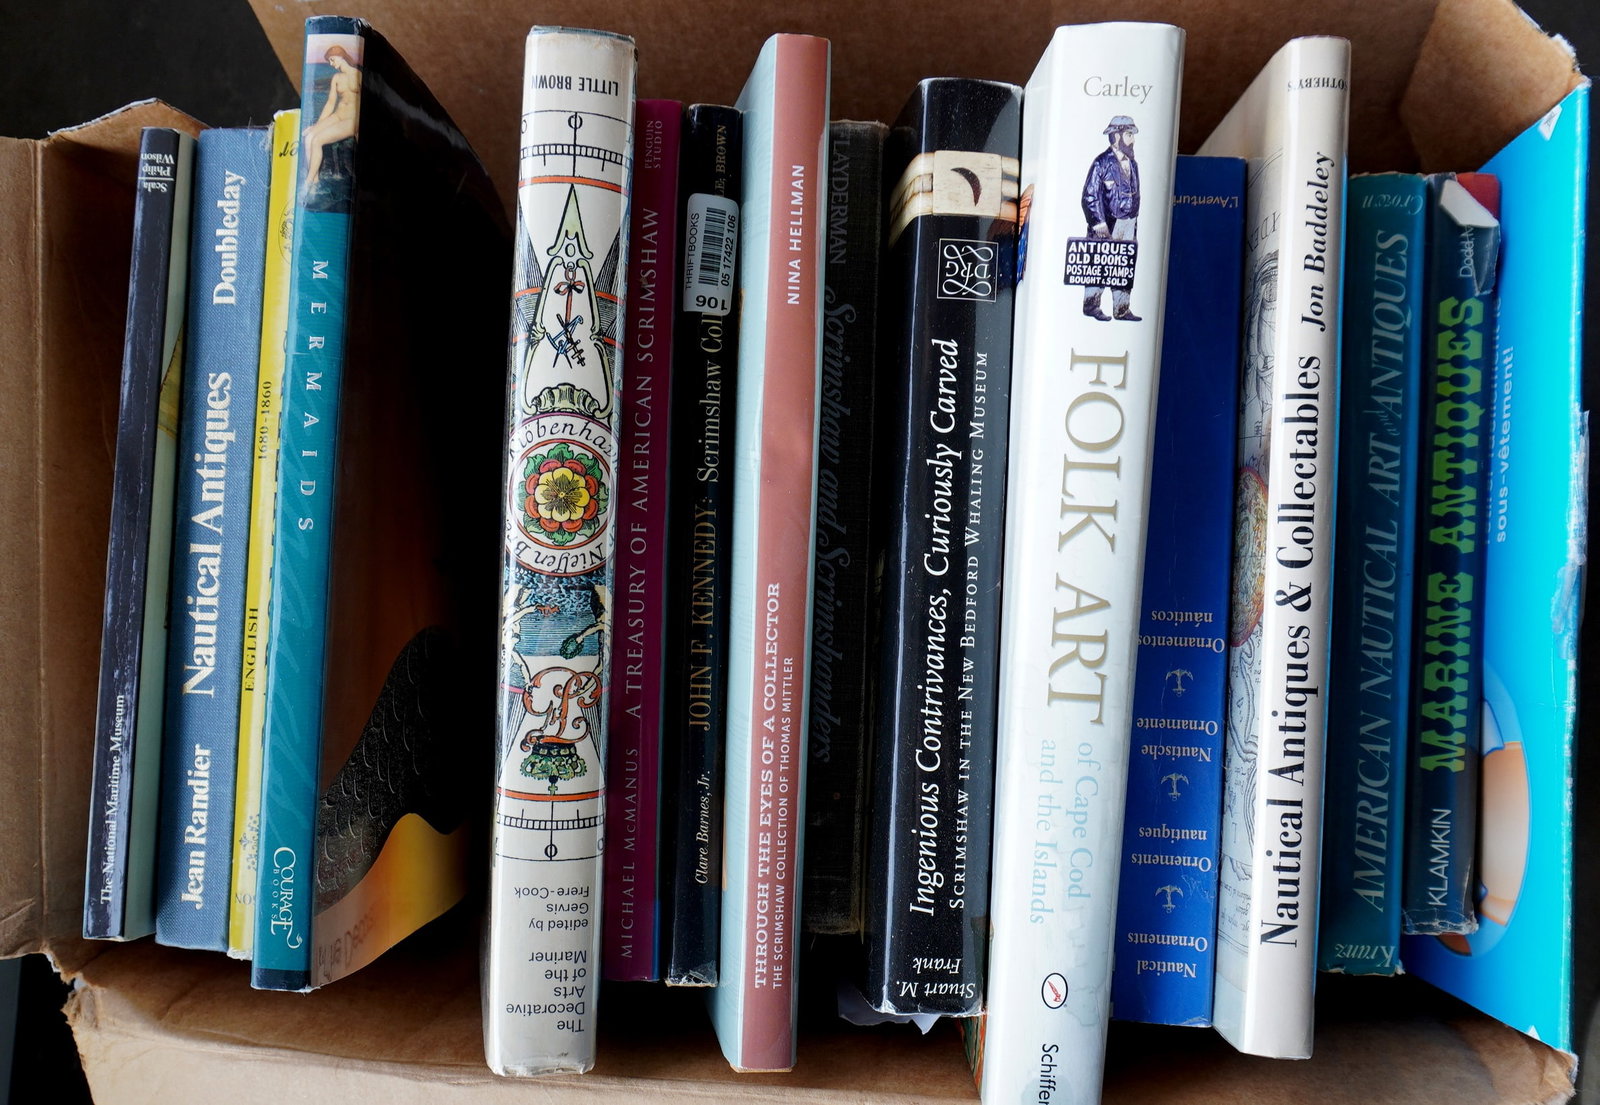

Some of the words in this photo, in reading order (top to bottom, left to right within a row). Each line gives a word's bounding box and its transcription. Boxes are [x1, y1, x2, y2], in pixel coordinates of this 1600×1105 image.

[531, 74, 572, 91] BROWN
[579, 77, 619, 97] LITTLE
[1083, 75, 1153, 104] Carley
[141, 153, 175, 165] Wilson
[645, 120, 655, 169] PENGUIN
[654, 120, 662, 169] STUDIO
[715, 124, 727, 174] BROWN
[142, 165, 172, 177] Philip
[143, 181, 168, 193] Scala
[727, 215, 736, 237] 106
[789, 164, 805, 251] HELLMAN
[1304, 152, 1335, 275] Baddeley
[213, 170, 248, 305] Doubleday
[685, 212, 700, 290] THRIFTBOOKS
[722, 239, 734, 268] 17422
[1068, 242, 1135, 256] ANTIQUES
[1068, 253, 1091, 265] OLD
[1094, 254, 1128, 267] BOOKS
[636, 208, 659, 362] SCRIMSHAW
[721, 271, 731, 287] 05
[787, 259, 801, 305] NINA
[1066, 265, 1102, 276] POSTAGE
[1103, 266, 1134, 278] STAMPS
[1069, 276, 1101, 285] BOUGHT
[1106, 277, 1128, 286] SOLD
[1301, 283, 1326, 332] Jon
[1371, 230, 1412, 418] ANTIQUES
[298, 260, 329, 531] MERMAIDS
[821, 285, 857, 463] Scrimshaw
[930, 338, 959, 434] Carved
[631, 376, 651, 512] AMERICAN
[697, 360, 722, 483] Scrimshaw
[1428, 297, 1485, 554] ANTIQUES
[1496, 346, 1515, 543] sous-vêtement!
[191, 372, 236, 537] Antiques
[1058, 348, 1128, 553] FOLK
[1275, 356, 1321, 569] Collectables
[1369, 432, 1400, 506] ART
[817, 468, 846, 534] and
[924, 443, 962, 577] Curiously
[630, 523, 648, 554] OF
[691, 496, 717, 626] KENNEDY:
[182, 543, 223, 699] Nautical
[1152, 610, 1213, 627] náuticos
[1274, 581, 1312, 613] &
[1360, 520, 1398, 700] NAUTICAL
[245, 607, 259, 693] ENGLISH
[626, 566, 646, 694] TREASURY
[691, 633, 713, 655] F.
[764, 583, 779, 711] COLLECTOR
[811, 528, 851, 764] Scrimshanders
[1047, 572, 1112, 728] ART
[1137, 635, 1225, 653] Ornamentos
[689, 664, 713, 731] JOHN
[783, 657, 793, 712] MITTLER
[916, 589, 953, 772] Contrivances,
[1419, 572, 1474, 773] MARINE
[109, 694, 126, 754] Museum
[626, 704, 641, 719] A
[764, 715, 775, 732] A
[1136, 718, 1218, 736] Ornamente
[1268, 625, 1318, 786] Antiques
[762, 736, 774, 765] OF
[780, 716, 791, 772] THOMAS
[1040, 739, 1063, 784] and
[1077, 742, 1101, 771] of
[1141, 745, 1212, 762] Nautische
[106, 755, 122, 817] Maritime
[184, 743, 213, 846] Randier
[697, 769, 711, 790] Jr.
[760, 768, 773, 827] EYES
[779, 775, 789, 793] OF
[696, 792, 712, 844] Barnes,
[1036, 793, 1062, 832] the
[1066, 775, 1098, 838] Cape
[1352, 711, 1392, 913] AMERICAN
[103, 818, 119, 880] National
[758, 832, 771, 876] THE
[776, 797, 788, 880] COLLECTION
[910, 782, 944, 916] Ingenious
[1139, 823, 1207, 844] nautiques
[1429, 808, 1452, 906] KLAMKIN
[181, 851, 206, 910] Jean
[694, 847, 708, 885] Clare
[1030, 841, 1058, 924] Islands
[1068, 847, 1093, 900] Cod
[1131, 853, 1212, 872] Ornements
[1260, 797, 1305, 947] Nautical
[100, 881, 114, 905] The
[270, 868, 280, 920] BOOKS
[270, 847, 301, 944] COURAGE
[514, 886, 589, 899] Frere-Cook
[547, 903, 589, 915] Gervis
[621, 862, 636, 958] MICHAEL
[529, 918, 544, 931] by
[547, 918, 588, 930] edited
[755, 883, 769, 988] THROUGH
[774, 884, 784, 961] SCRIMSHAW
[1128, 932, 1207, 952] Ornaments
[529, 950, 587, 963] Mariner
[544, 968, 570, 980] the
[573, 968, 587, 980] of
[773, 965, 783, 990] THE
[912, 957, 962, 974] Frank
[1137, 959, 1197, 978] Nautical
[506, 1001, 585, 1015] Decorative
[554, 985, 585, 998] Arts
[896, 979, 919, 998] M.
[924, 981, 976, 999] Stuart
[556, 1019, 584, 1033] The
[1038, 1043, 1059, 1105] Schiffer
